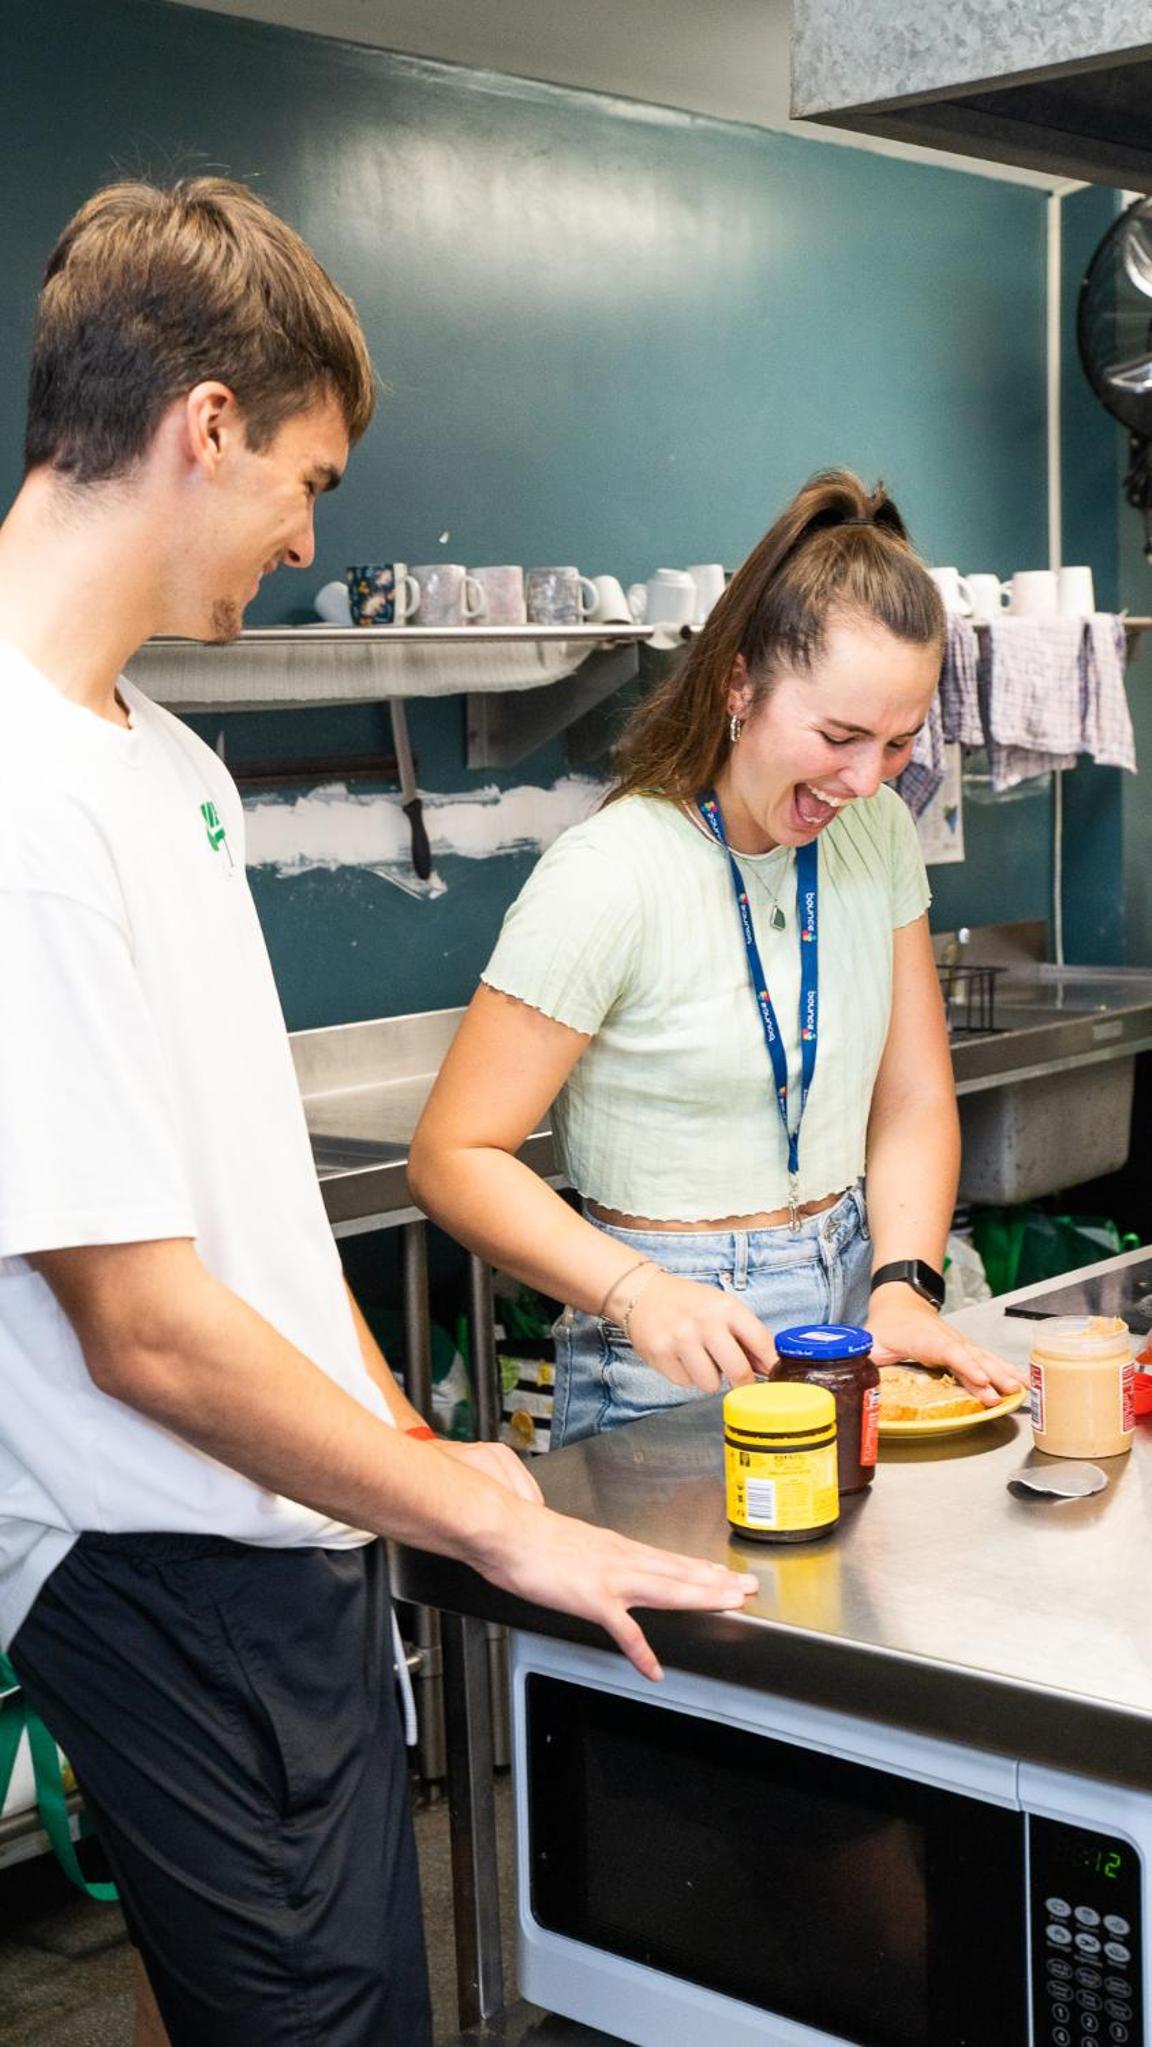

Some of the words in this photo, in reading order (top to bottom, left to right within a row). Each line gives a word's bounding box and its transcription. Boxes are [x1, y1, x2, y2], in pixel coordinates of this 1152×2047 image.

[806, 892, 815, 931] bounce
[760, 1002, 776, 1042] bounce
[807, 991, 816, 1029] bounce
